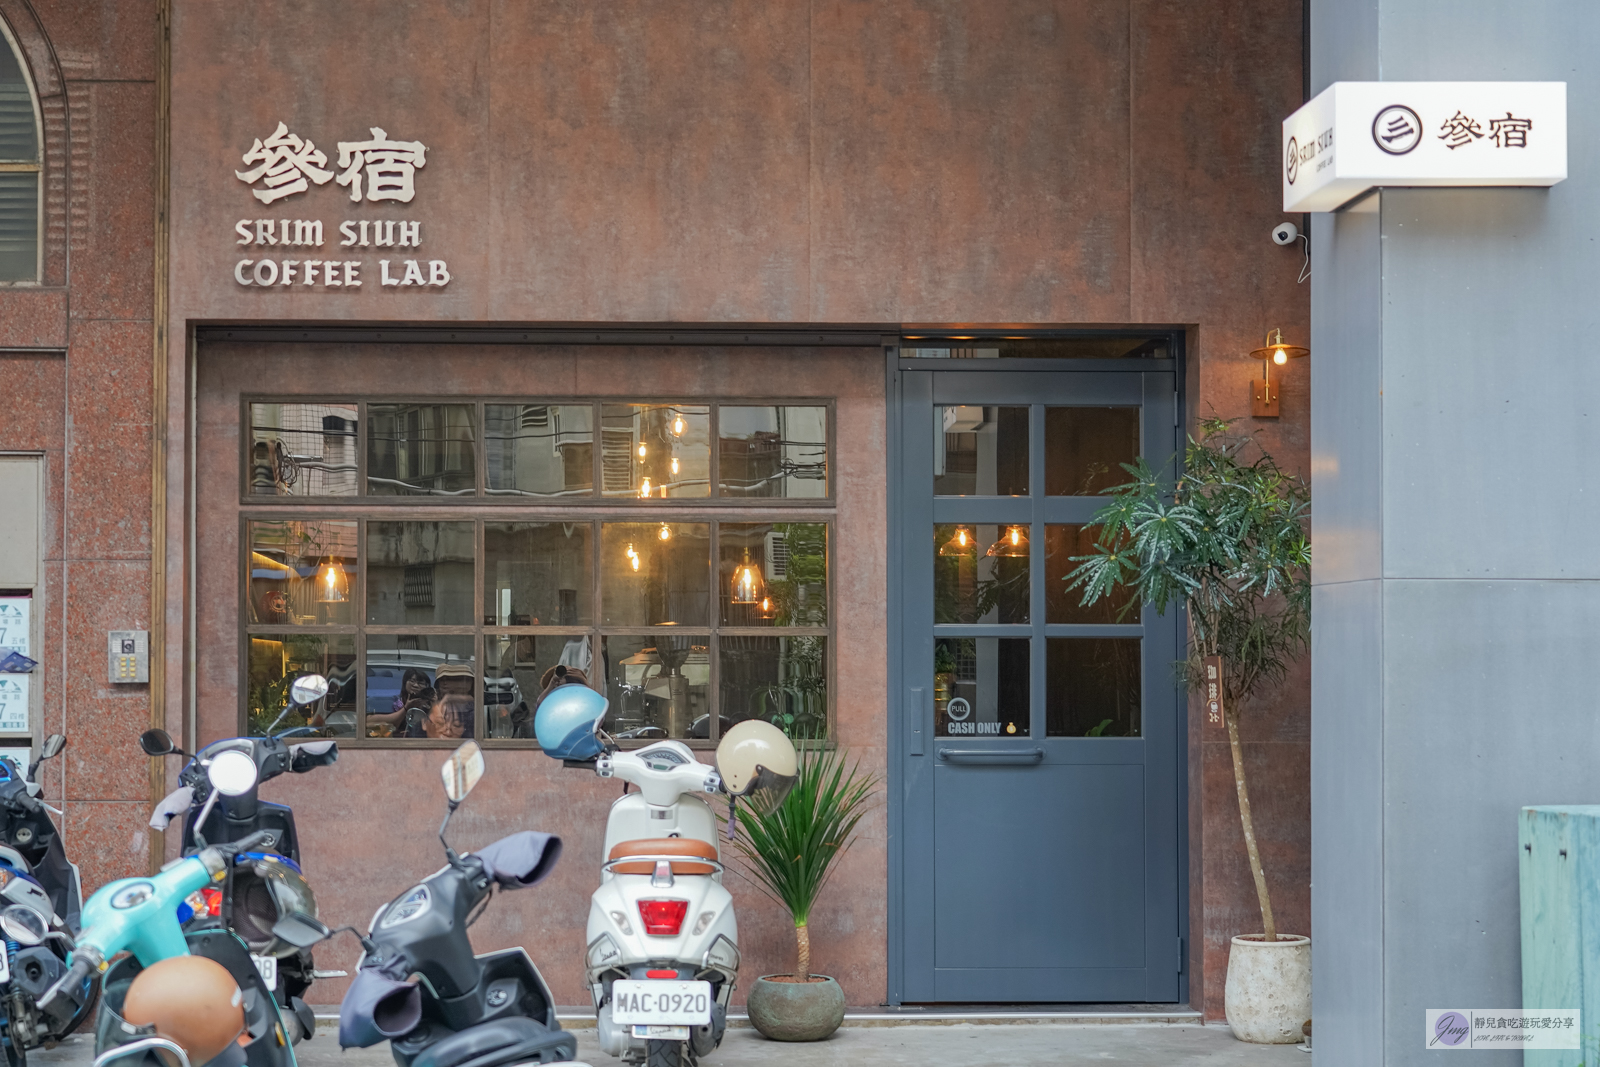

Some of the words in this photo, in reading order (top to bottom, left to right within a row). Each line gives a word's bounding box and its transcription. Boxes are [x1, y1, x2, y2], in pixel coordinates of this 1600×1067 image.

[1437, 110, 1533, 150] 參宿
[234, 121, 427, 204] 參宿
[235, 219, 325, 246] SRIM
[339, 220, 421, 247] SIUH
[234, 259, 363, 286] COFFEE
[379, 259, 451, 287] LAB
[947, 722, 976, 734] CASH
[977, 722, 1002, 734] ONLY
[616, 993, 706, 1013] MAC-0920
